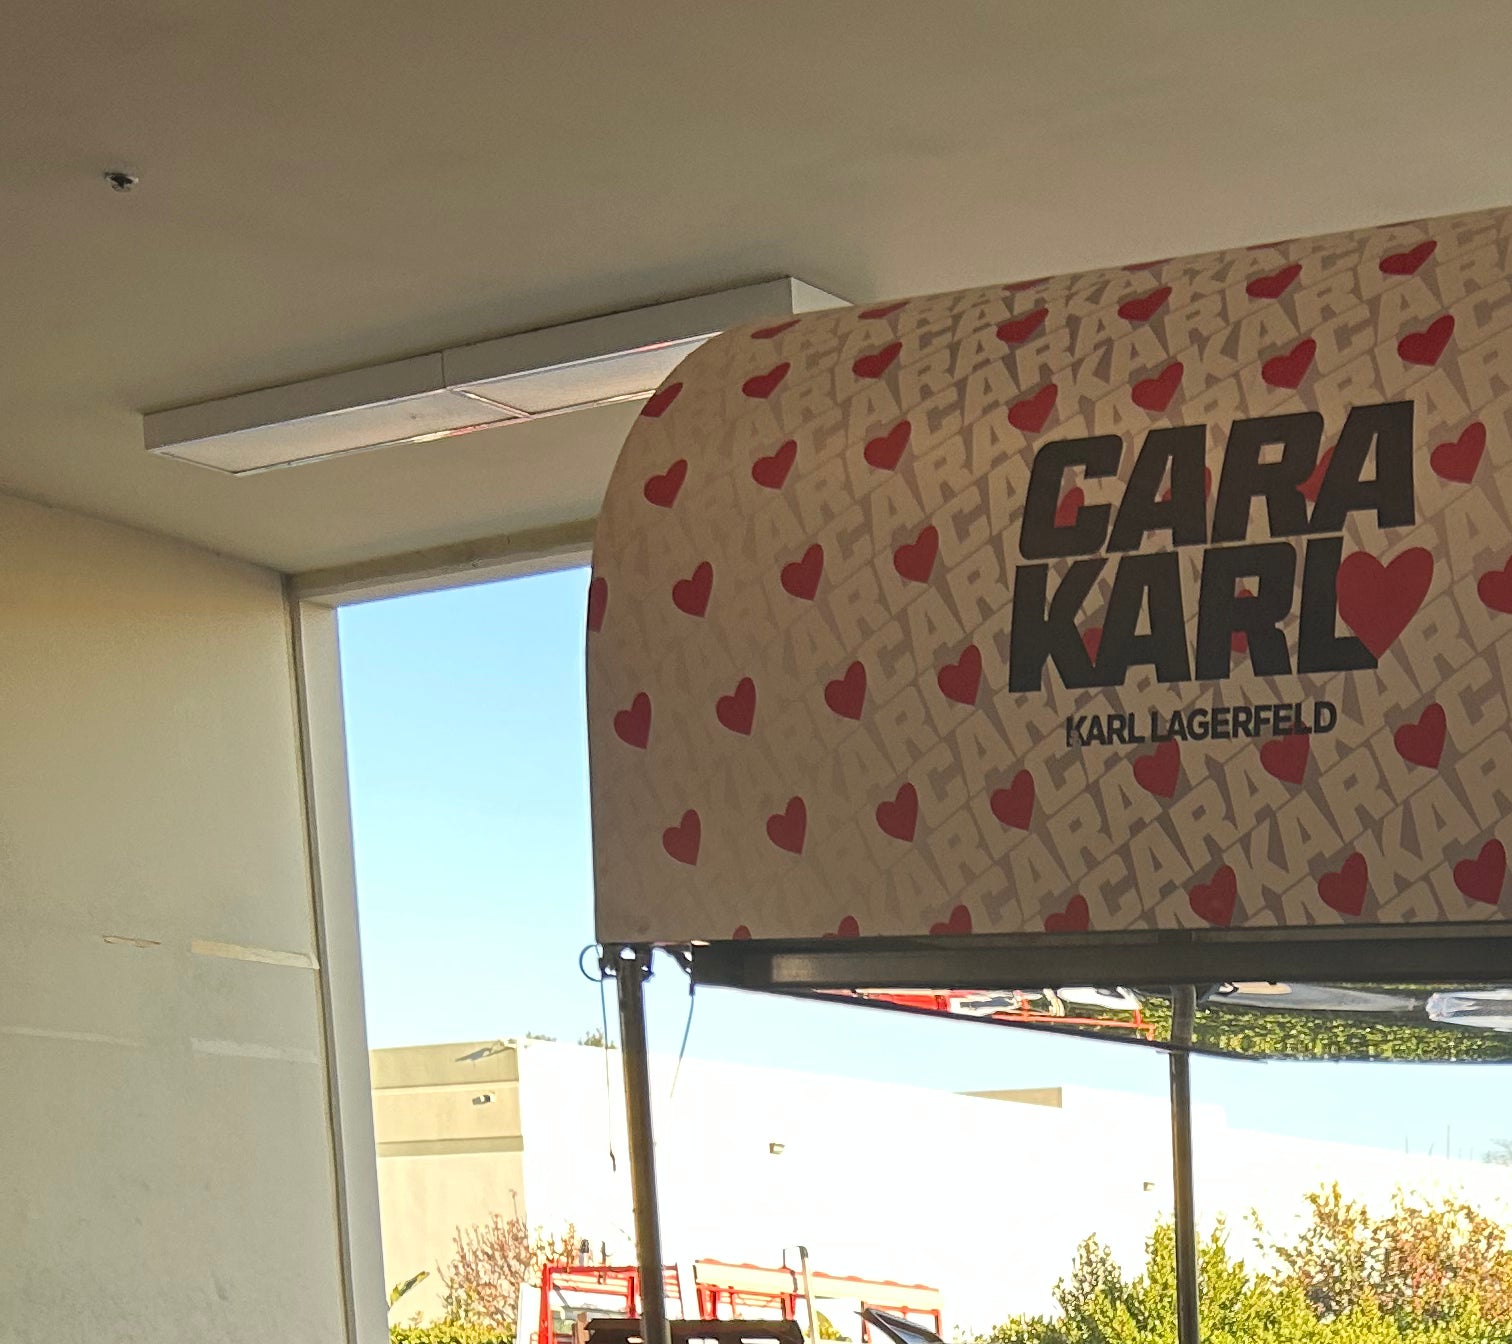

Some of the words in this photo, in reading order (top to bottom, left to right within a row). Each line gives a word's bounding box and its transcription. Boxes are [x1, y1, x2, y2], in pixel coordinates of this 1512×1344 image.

[1019, 400, 1416, 560] CARA
[1008, 537, 1380, 693] KARL
[1067, 714, 1146, 748] KARL
[1151, 701, 1338, 743] LAGERFELD
